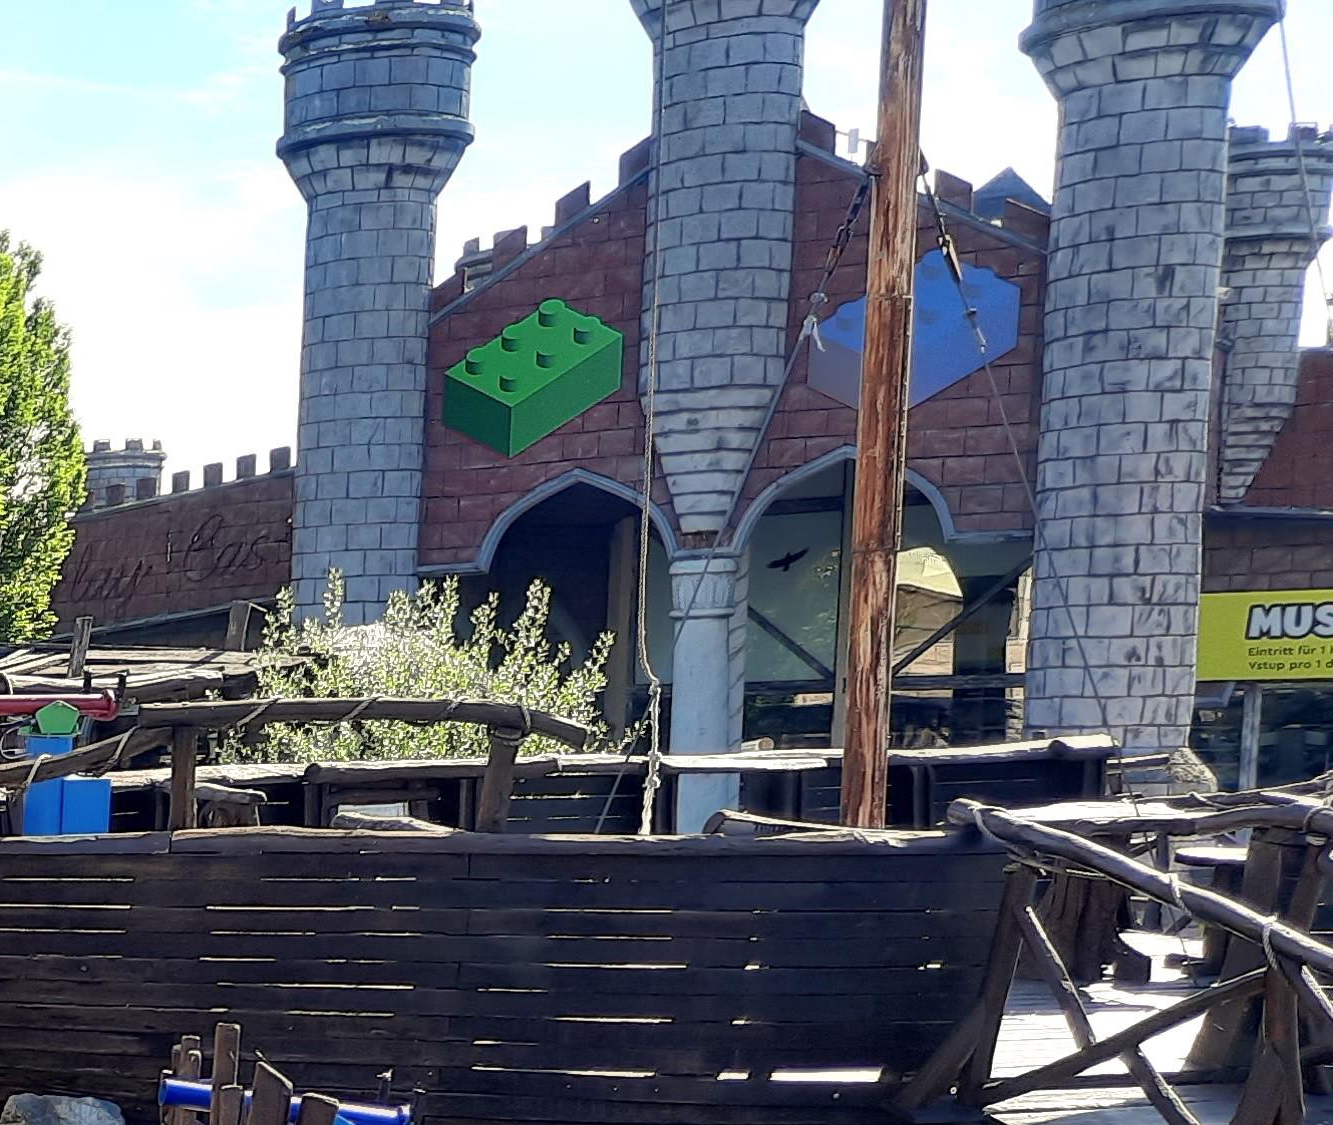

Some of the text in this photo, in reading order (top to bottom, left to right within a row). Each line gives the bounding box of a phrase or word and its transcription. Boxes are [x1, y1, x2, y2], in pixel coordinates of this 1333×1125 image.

[182, 514, 268, 583] Cas
[1245, 601, 1333, 640] MUS
[1247, 646, 1294, 657] Eintritt
[1298, 645, 1317, 655] für
[1320, 645, 1326, 655] 1
[1248, 661, 1286, 671] Vstup
[1289, 661, 1312, 671] pro
[1315, 659, 1321, 669] 1
